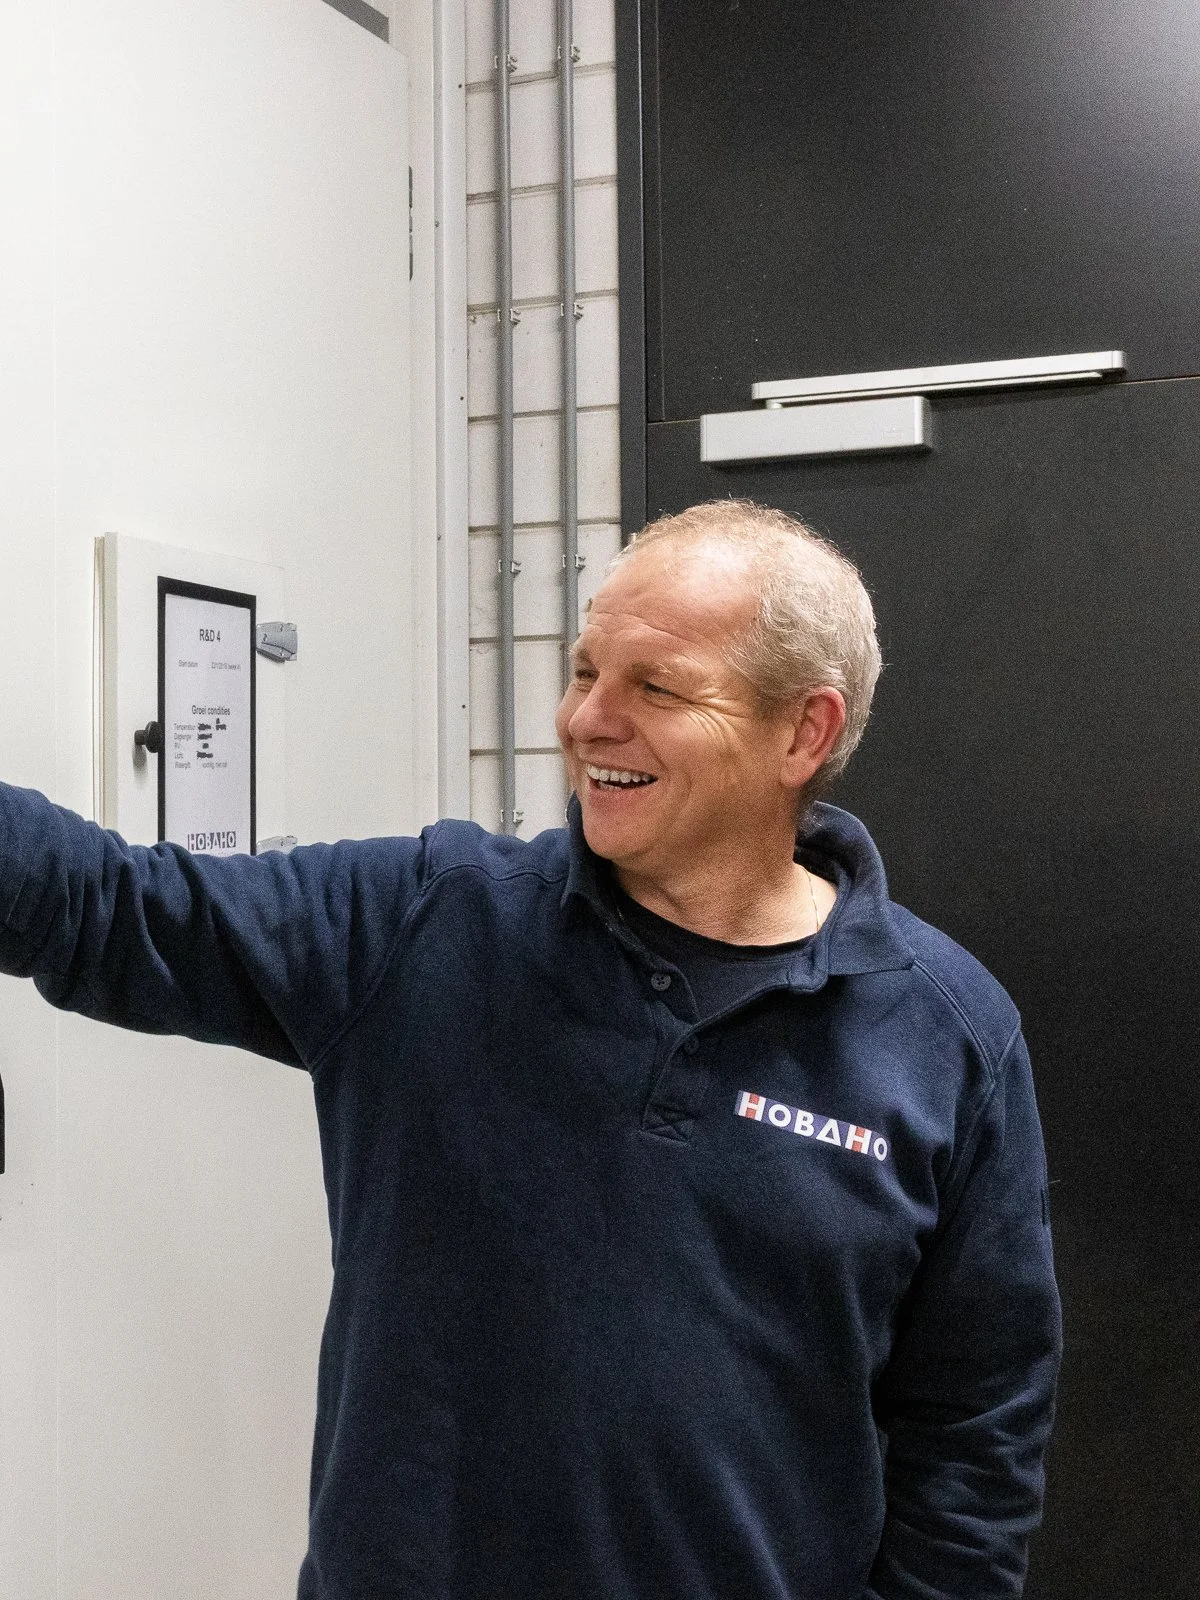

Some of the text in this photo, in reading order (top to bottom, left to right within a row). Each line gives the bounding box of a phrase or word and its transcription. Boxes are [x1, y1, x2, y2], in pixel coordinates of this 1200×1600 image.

[199, 628, 215, 642] R&D
[191, 704, 231, 716] Groei condities
[188, 831, 236, 851] HOBAHO
[738, 1091, 888, 1162] HOBAHO
